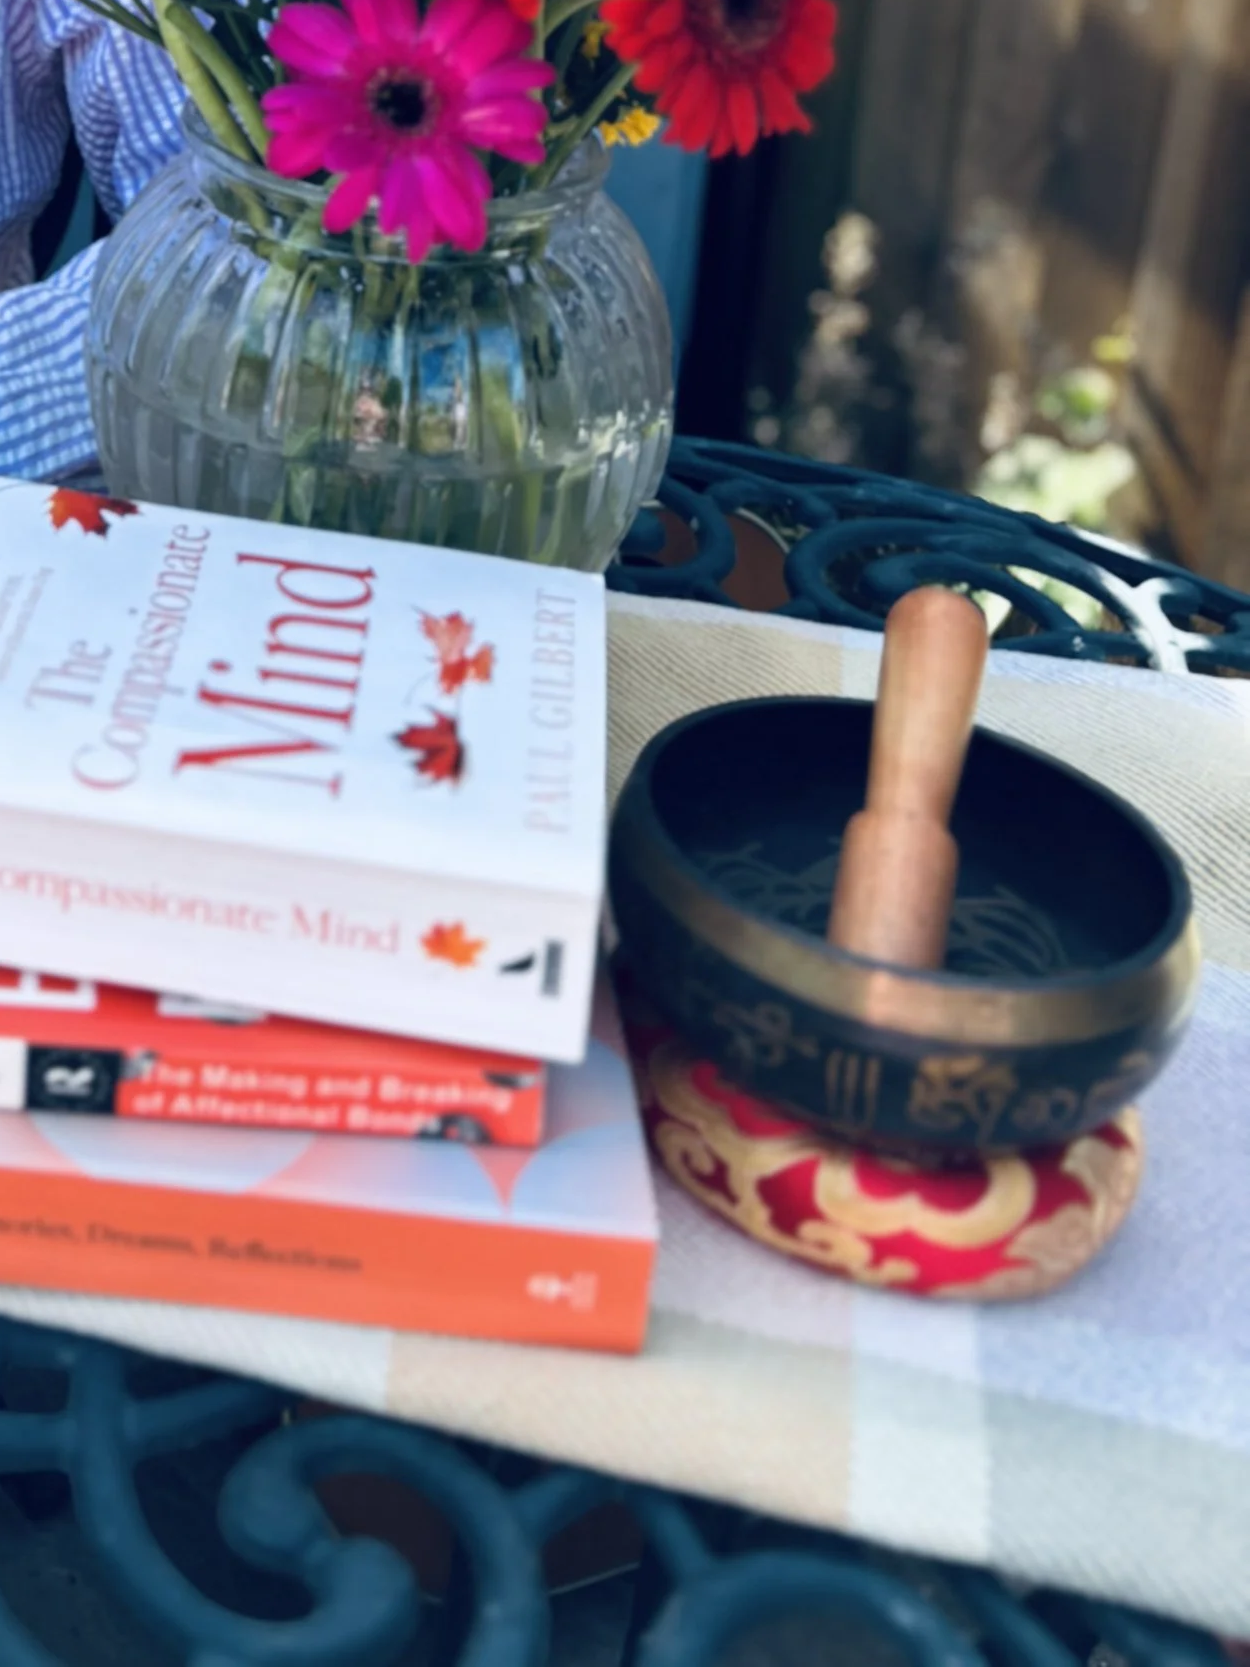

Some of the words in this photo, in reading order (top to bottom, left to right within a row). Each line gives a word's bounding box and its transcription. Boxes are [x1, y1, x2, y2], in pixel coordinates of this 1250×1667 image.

[23, 639, 112, 710] The
[70, 523, 211, 792] Compassionate
[172, 551, 378, 800] Mind
[527, 586, 578, 731] GILBERT
[289, 903, 402, 955] Mind
[132, 1092, 165, 1114] of
[170, 1094, 338, 1127] Affectional
[200, 1064, 307, 1098] Making
[315, 1072, 362, 1098] and
[377, 1076, 514, 1113] Breaking
